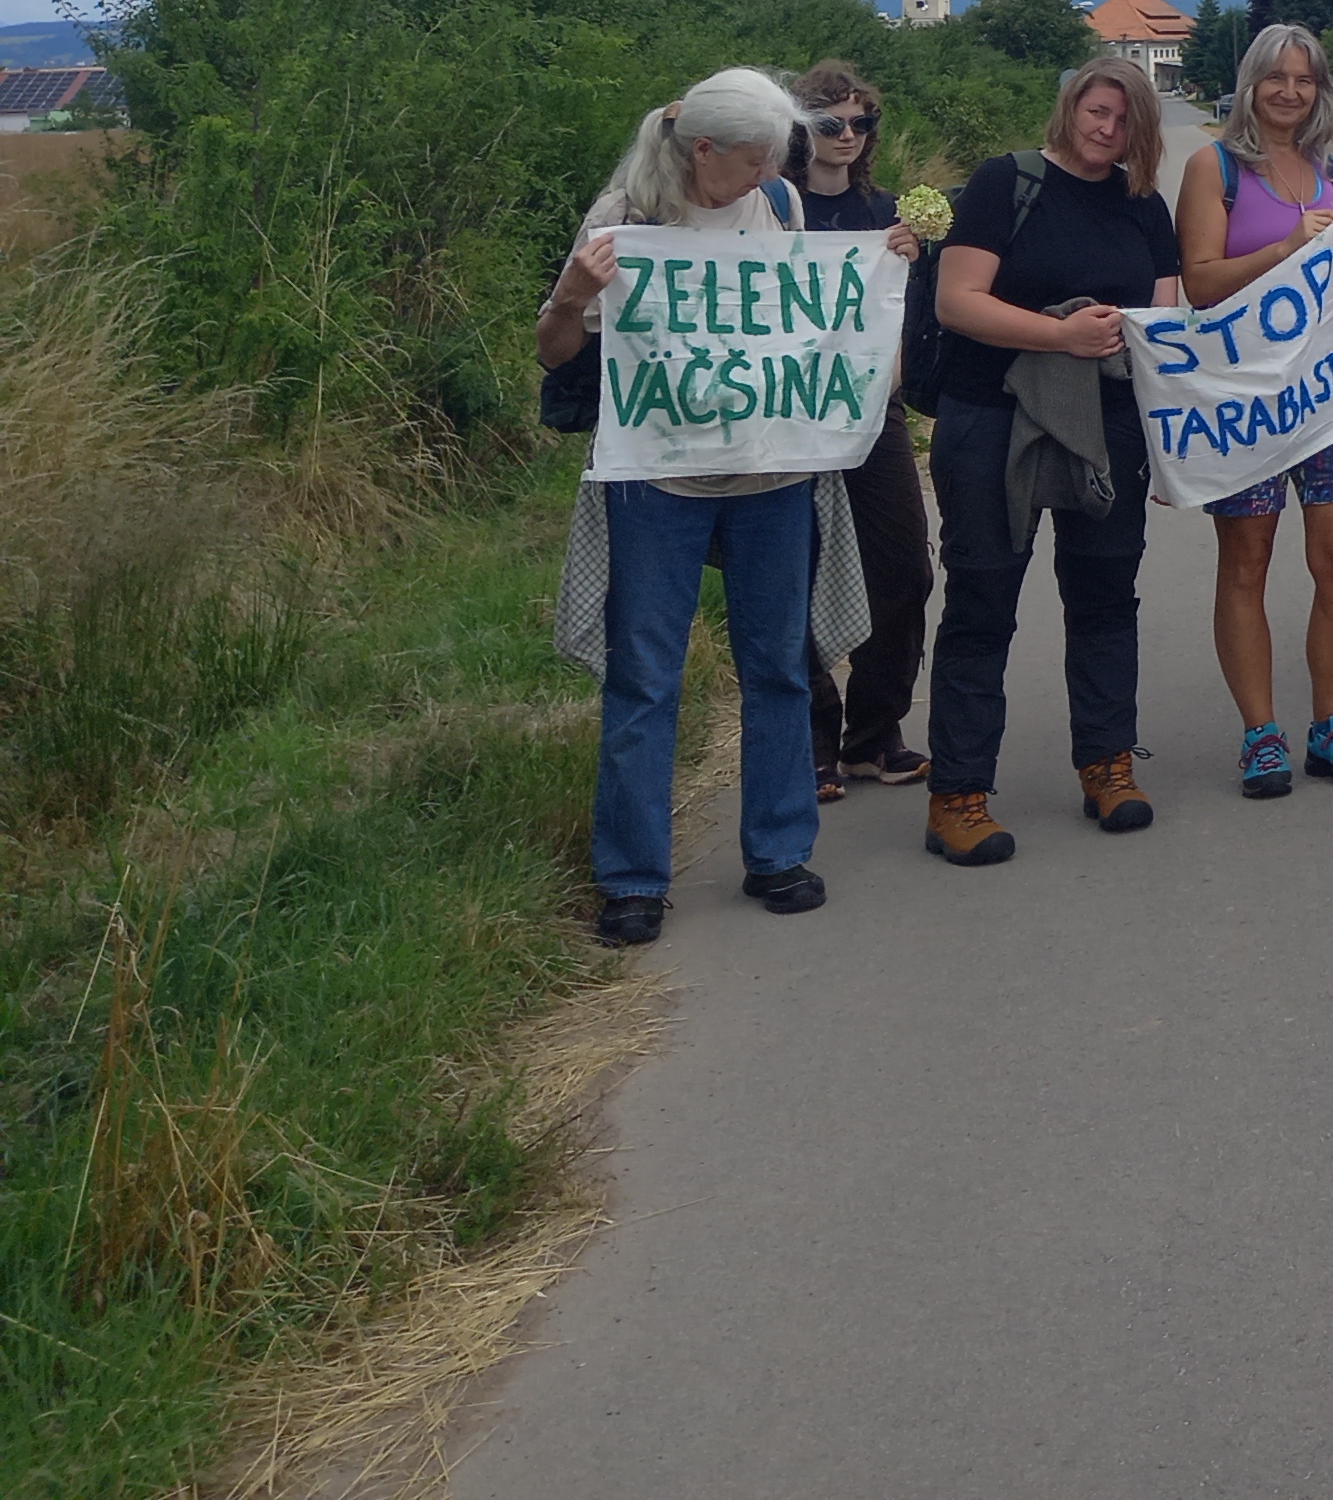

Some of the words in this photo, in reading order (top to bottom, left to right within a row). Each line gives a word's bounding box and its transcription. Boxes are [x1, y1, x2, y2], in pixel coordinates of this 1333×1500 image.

[614, 246, 865, 336] ZELENÁ
[1145, 247, 1333, 375] STOP
[606, 347, 863, 428] VÄČŠINA
